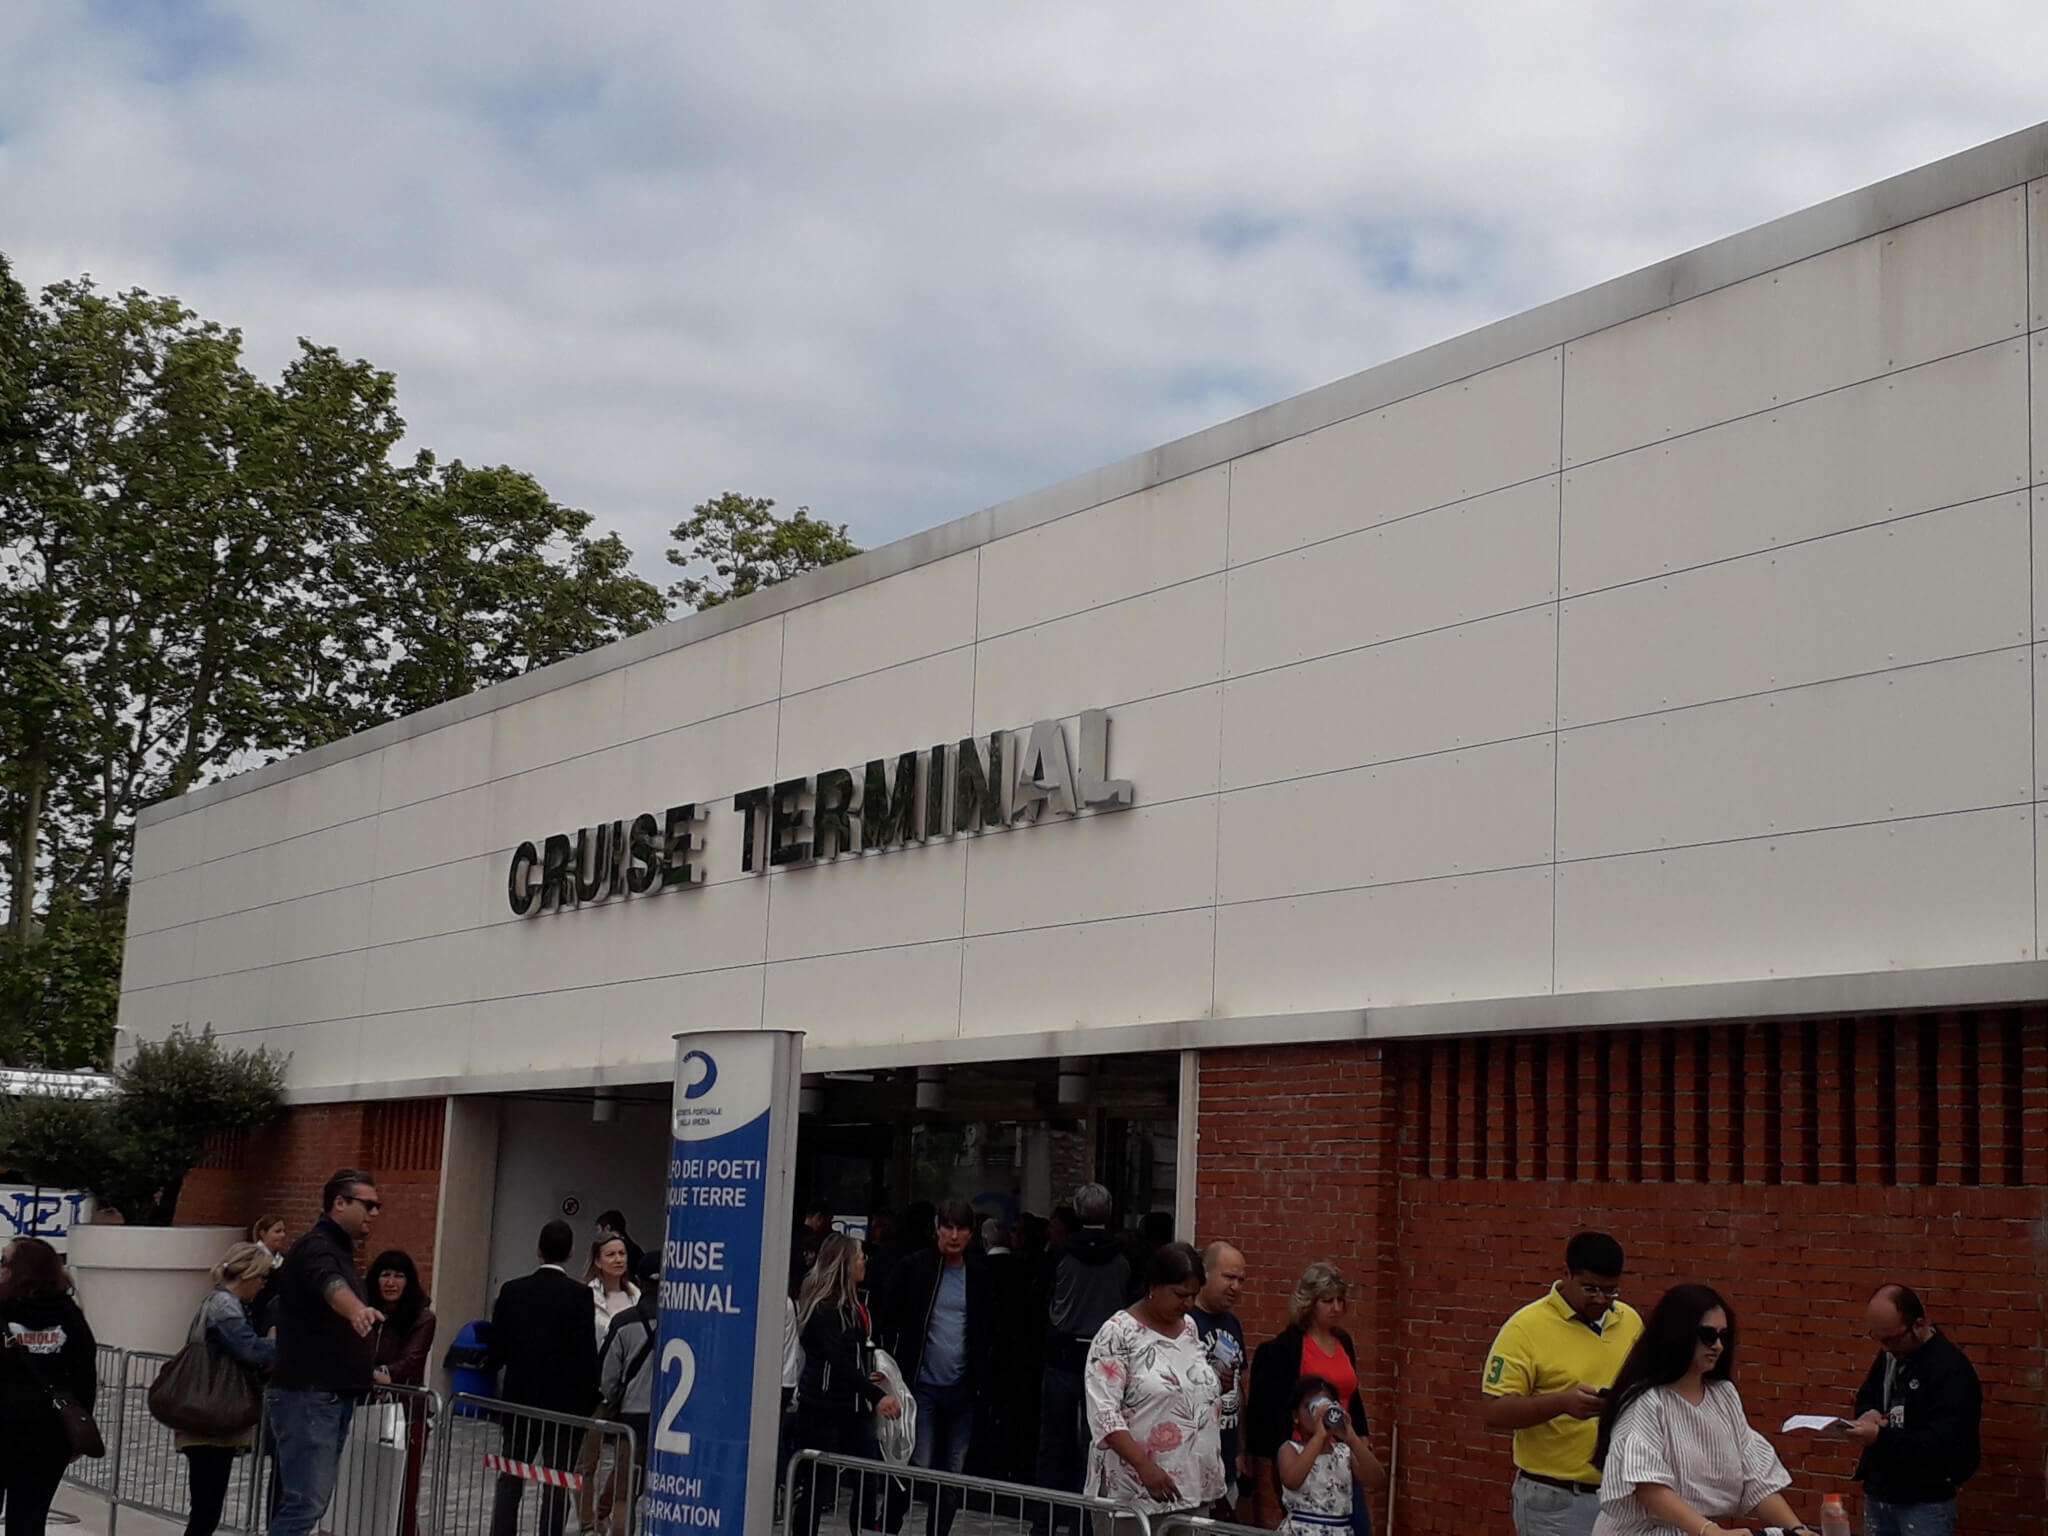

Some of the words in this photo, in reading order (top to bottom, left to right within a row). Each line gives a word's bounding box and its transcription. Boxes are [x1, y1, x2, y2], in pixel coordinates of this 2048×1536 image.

[508, 801, 709, 915] CRUISE
[733, 708, 1133, 873] TERMINAL
[682, 1159, 704, 1179] DEI
[706, 1159, 761, 1180] POETI
[691, 1187, 747, 1208] TERRE
[1486, 1355, 1505, 1385] 3
[654, 1337, 696, 1455] 2
